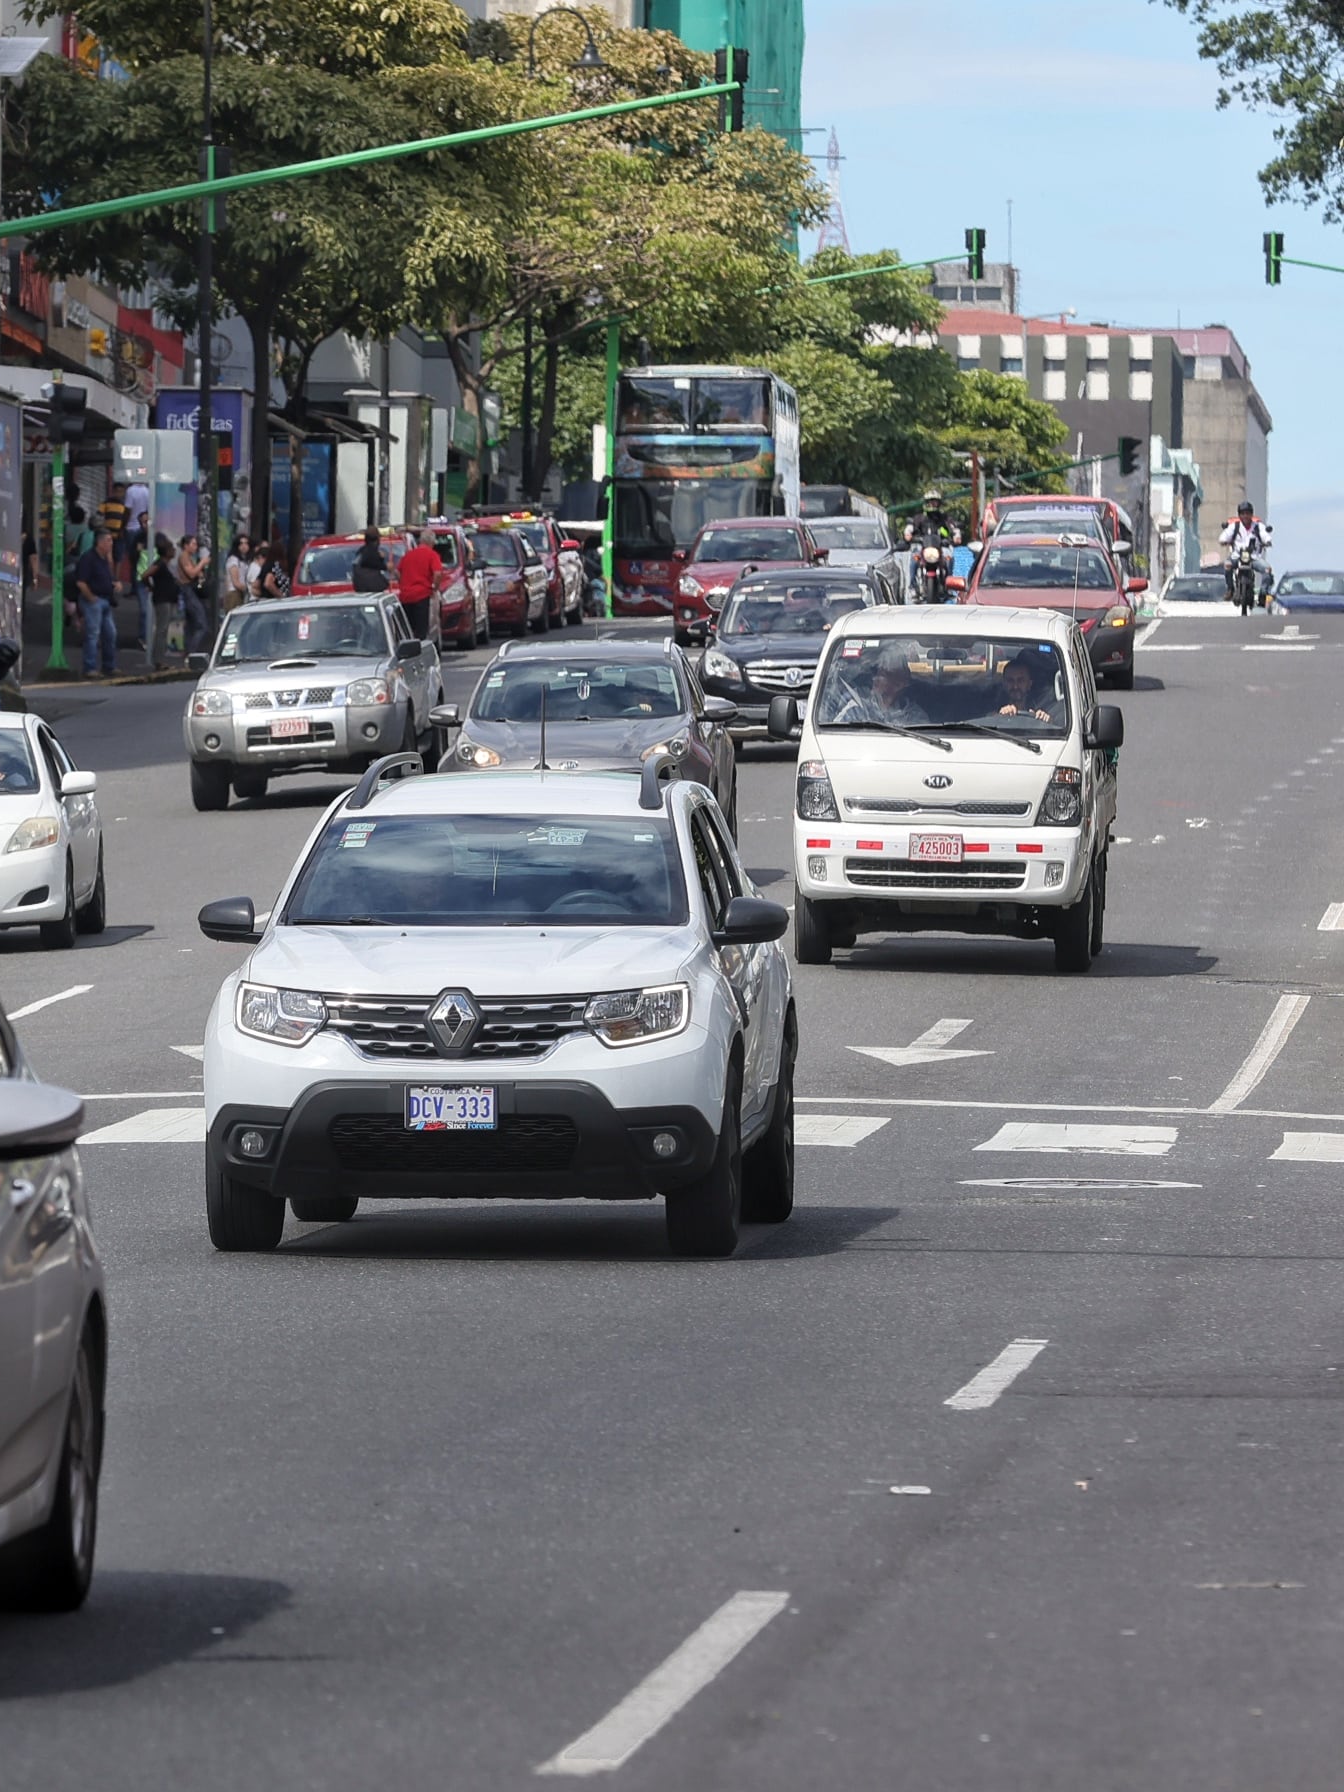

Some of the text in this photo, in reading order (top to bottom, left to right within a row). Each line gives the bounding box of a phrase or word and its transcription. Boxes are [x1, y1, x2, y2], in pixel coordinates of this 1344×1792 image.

[166, 405, 233, 431] fidÉtas
[927, 776, 949, 787] KIA
[918, 841, 959, 856] 425003
[409, 1096, 490, 1119] DCV-333
